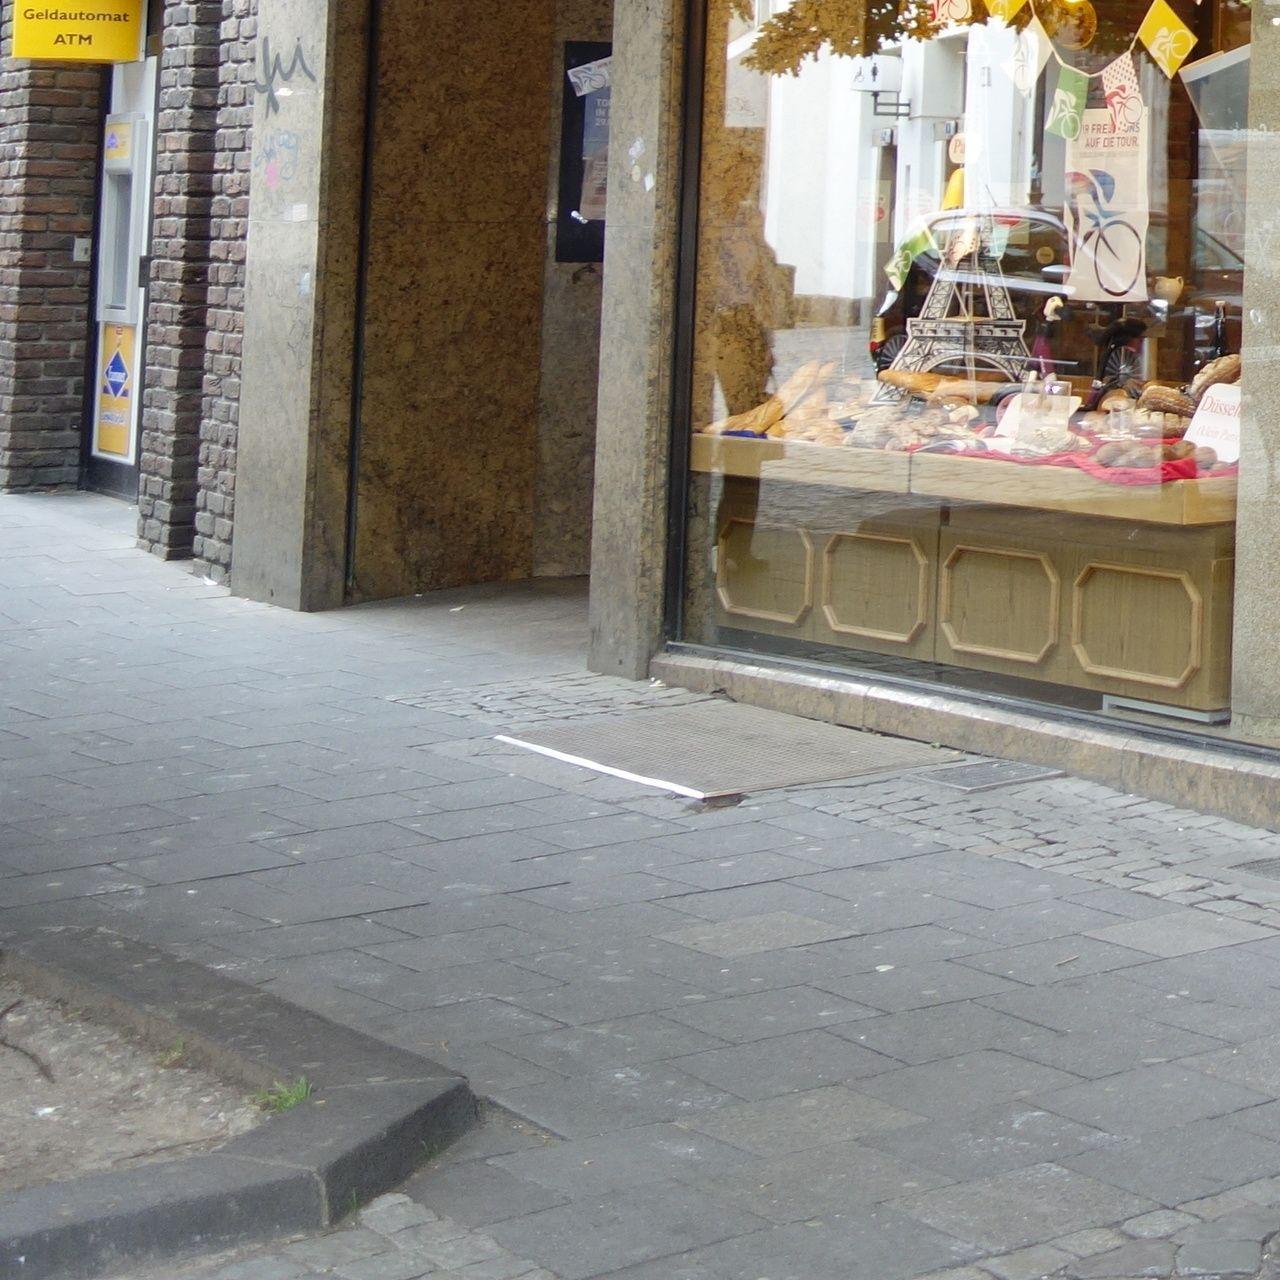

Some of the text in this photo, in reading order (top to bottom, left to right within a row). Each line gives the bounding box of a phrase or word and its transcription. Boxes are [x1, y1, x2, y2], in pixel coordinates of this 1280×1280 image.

[23, 8, 130, 22] Geldautomat
[53, 34, 93, 45] ATM
[1085, 137, 1101, 148] AUF
